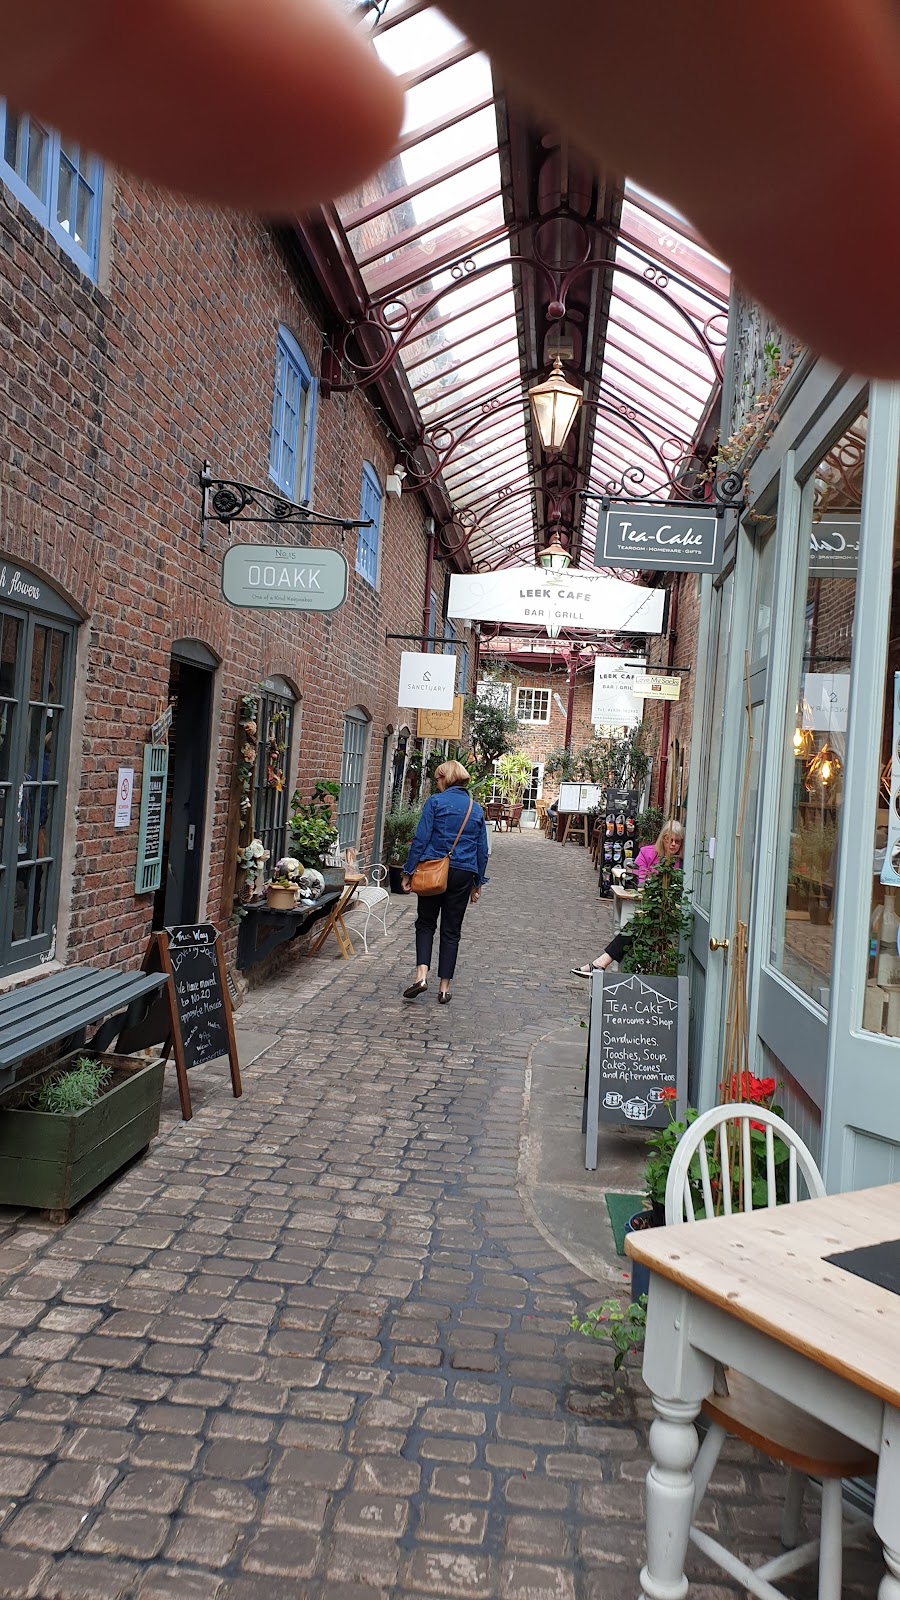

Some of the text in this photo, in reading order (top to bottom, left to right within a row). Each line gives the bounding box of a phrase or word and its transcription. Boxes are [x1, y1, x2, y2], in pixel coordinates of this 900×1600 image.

[619, 522, 703, 546] Tea-Cake
[248, 565, 321, 590] OOAKK
[7, 571, 40, 600] flowers
[519, 589, 592, 602] LEEK CAFE
[524, 608, 584, 620] BAR GRILL
[407, 683, 447, 692] SANCTUARY
[192, 929, 209, 944] Way
[175, 972, 217, 994] We have moved
[180, 997, 190, 1008] to
[181, 1005, 204, 1024] opposite
[603, 1013, 645, 1025] Tearooms
[651, 1015, 674, 1031] Shop
[632, 1061, 661, 1073] Scones
[602, 1070, 676, 1084] and Afternoon Teas
